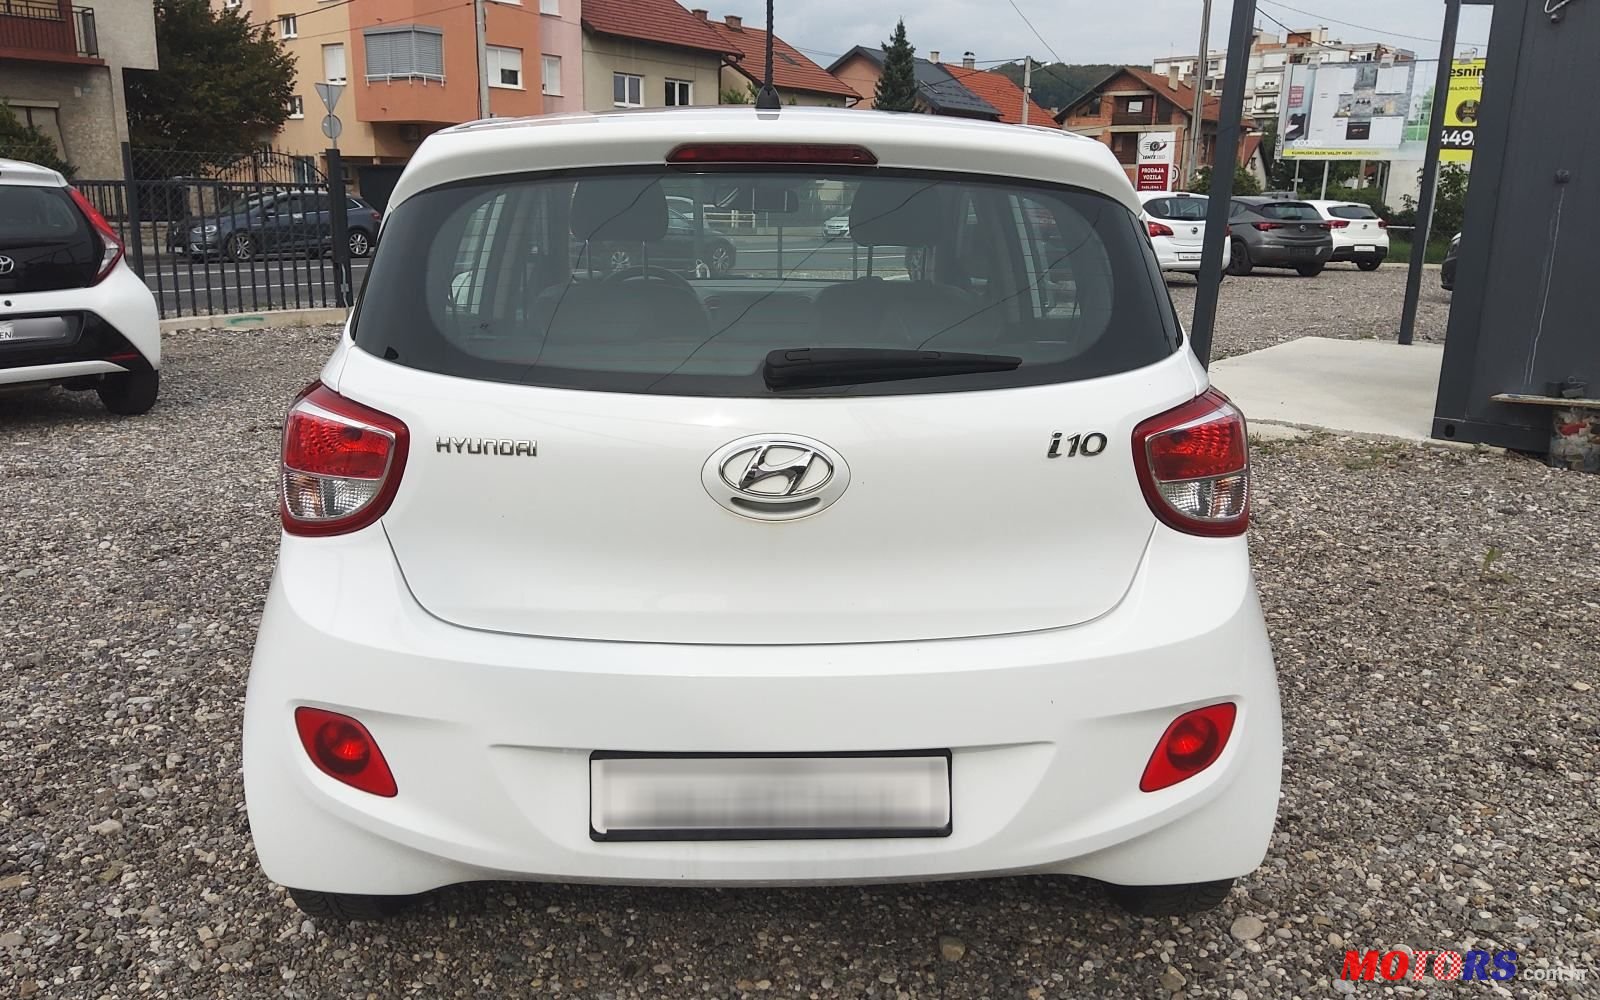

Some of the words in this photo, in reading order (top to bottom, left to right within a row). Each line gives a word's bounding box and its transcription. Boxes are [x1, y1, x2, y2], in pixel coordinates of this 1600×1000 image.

[1449, 65, 1485, 77] esnin
[0, 331, 12, 339] EN
[436, 436, 537, 457] HYUNDAI
[1047, 430, 1108, 459] i10
